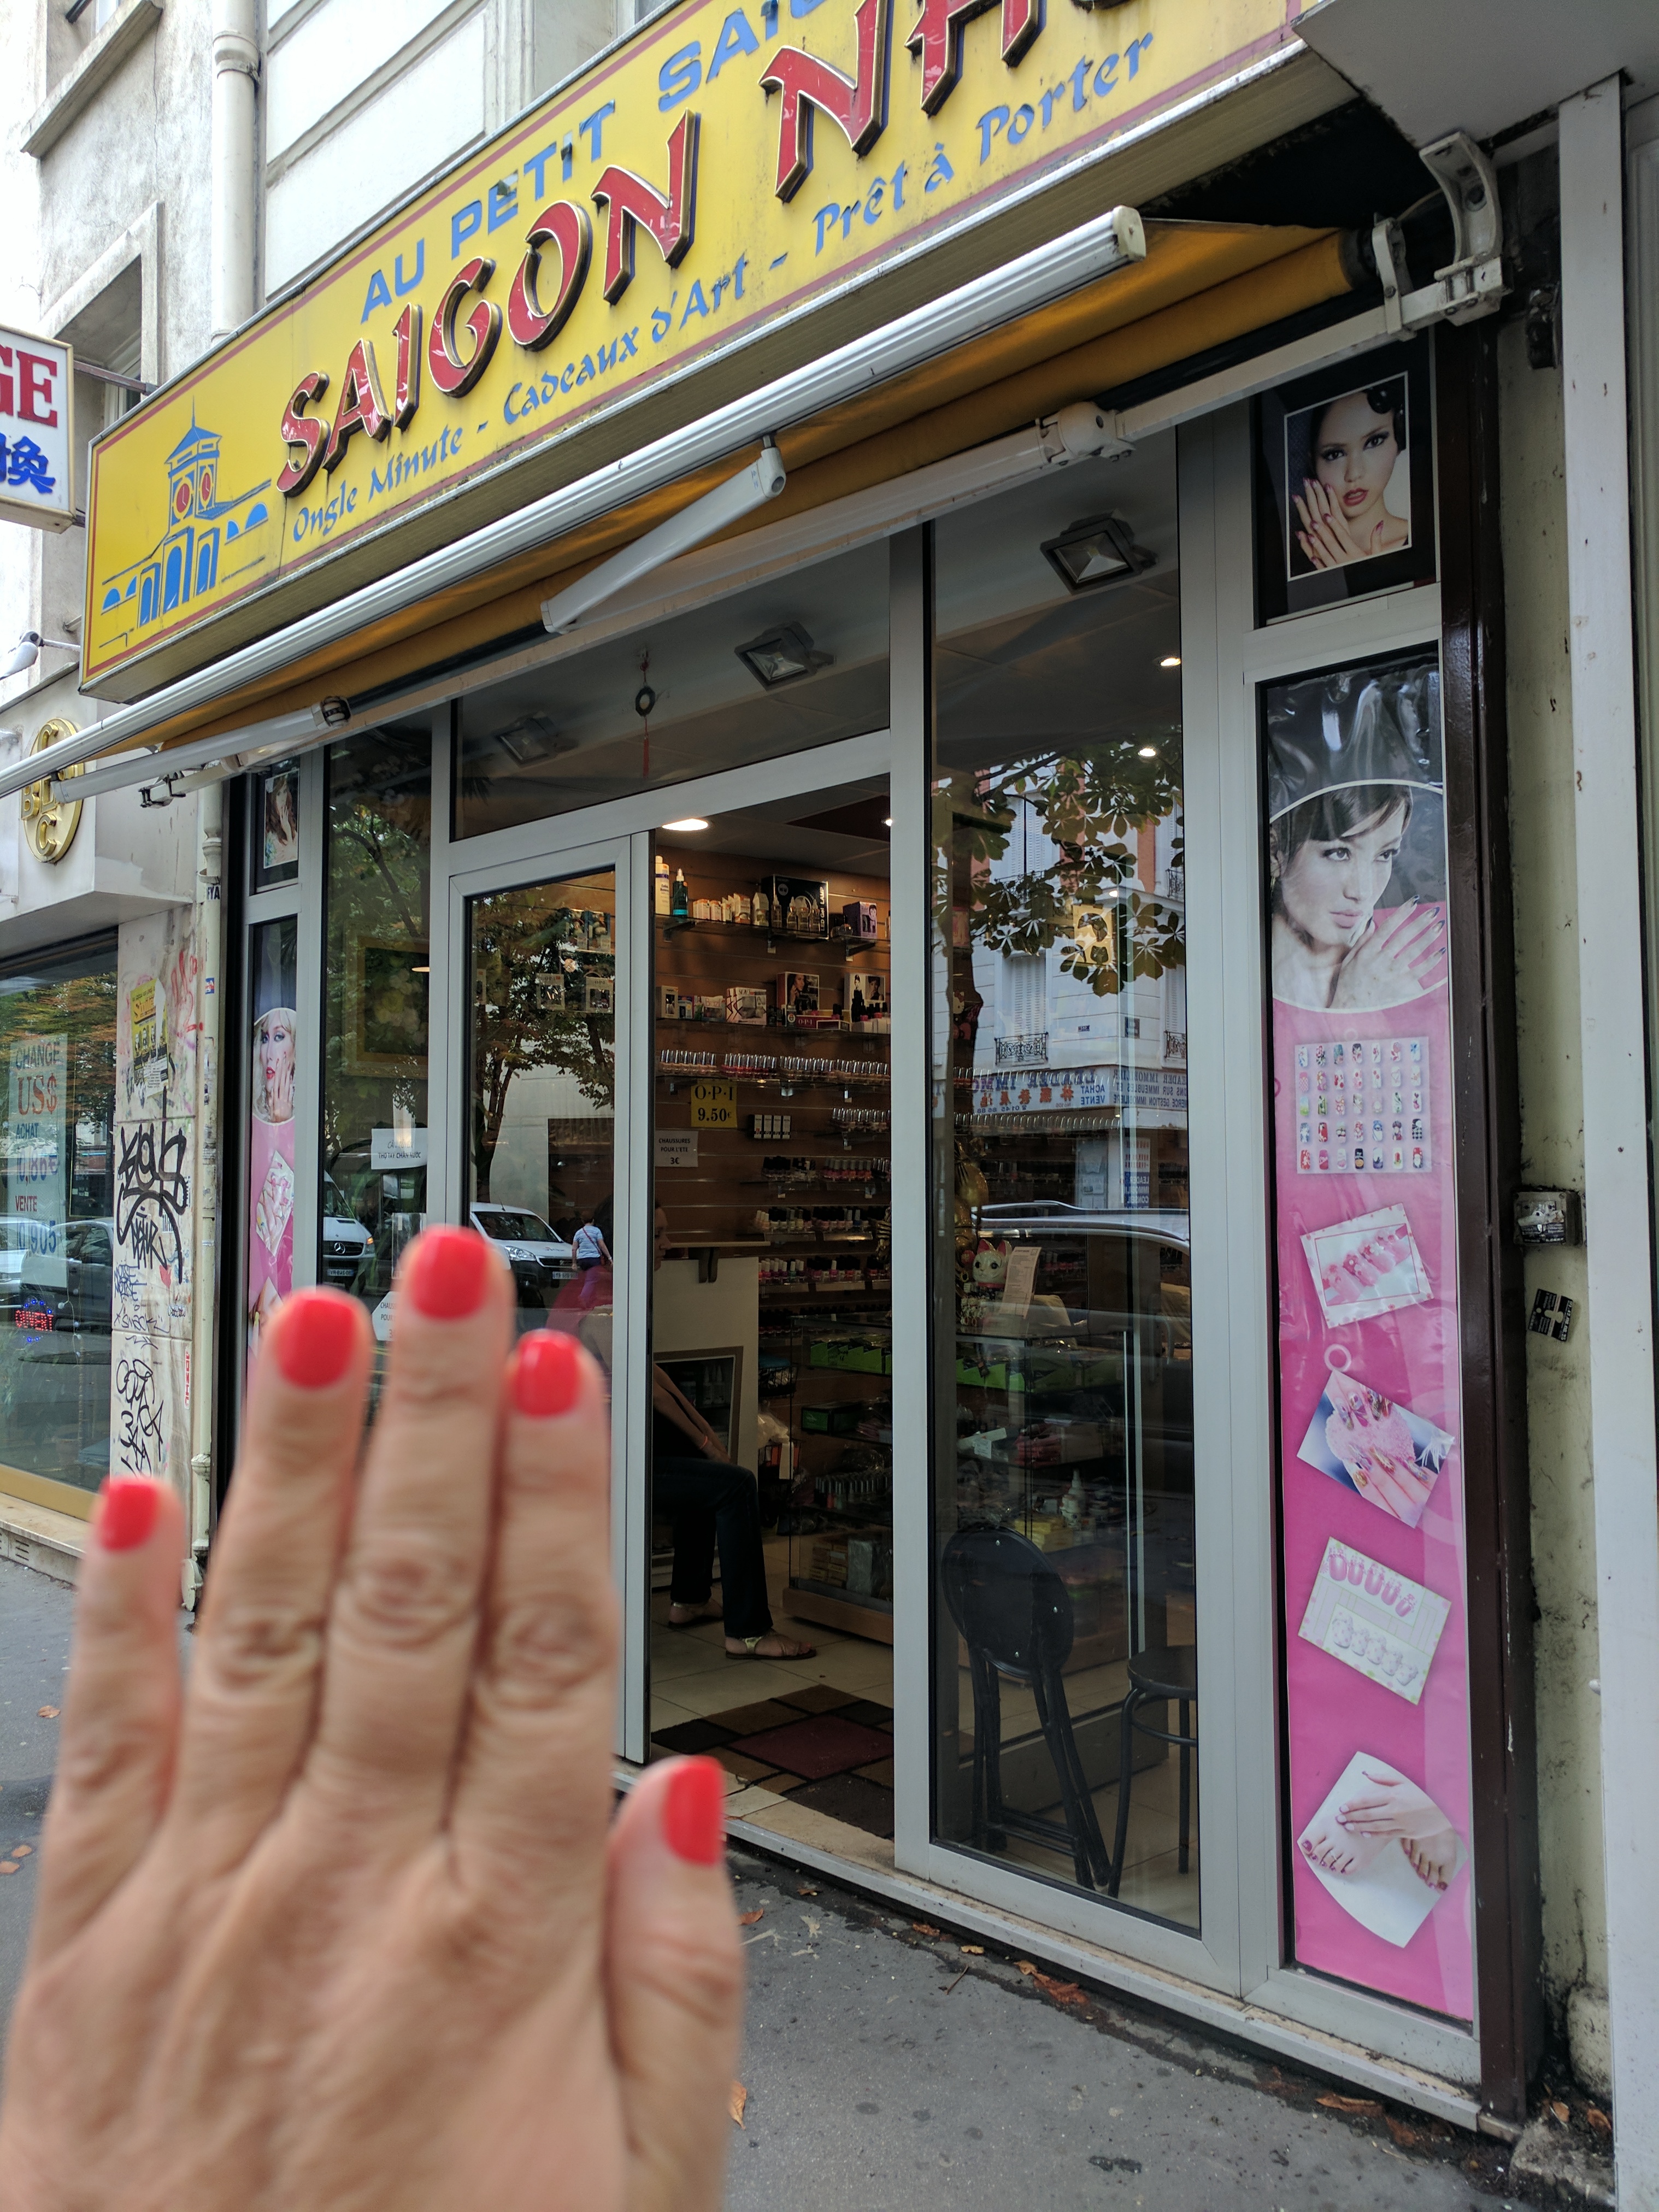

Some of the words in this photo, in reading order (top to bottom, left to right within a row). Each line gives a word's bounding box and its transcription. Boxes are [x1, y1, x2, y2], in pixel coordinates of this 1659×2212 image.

[293, 480, 358, 542] Ongle
[368, 424, 463, 501] Minute
[504, 326, 639, 425] Cadeaux
[651, 251, 749, 344] d'Art
[813, 161, 908, 256] Prêt
[924, 142, 955, 193] à
[975, 32, 1154, 166] Porter
[360, 238, 425, 324] AU
[276, 108, 701, 497] SAIGON
[15, 1041, 60, 1070] CHANGE
[17, 1072, 58, 1115] US$
[16, 1123, 39, 1140] ACHAT
[15, 1196, 38, 1213] VENTE
[15, 1309, 54, 1332] OUVERT
